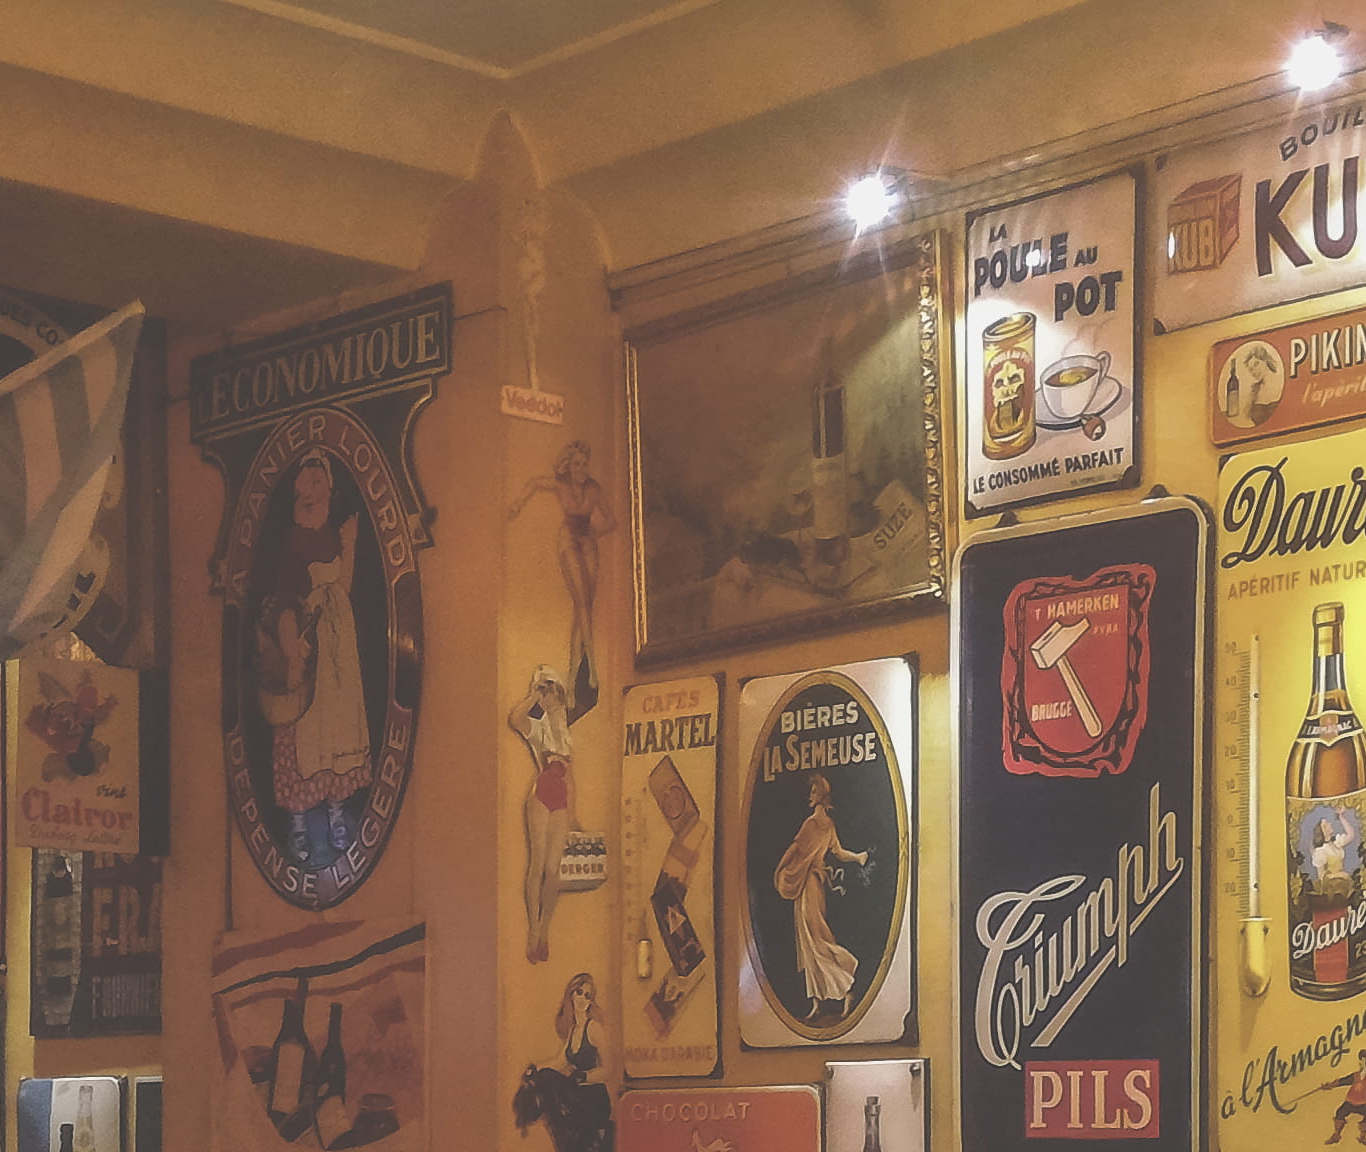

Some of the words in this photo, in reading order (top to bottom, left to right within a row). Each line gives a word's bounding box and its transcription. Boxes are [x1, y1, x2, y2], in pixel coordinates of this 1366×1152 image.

[989, 223, 1007, 244] LA
[974, 232, 1069, 297] POULE
[1074, 246, 1099, 268] AU
[1054, 270, 1124, 322] POT
[337, 423, 406, 567] LOURD
[973, 476, 985, 494] LE
[988, 456, 1061, 492] CONSOMMÉ
[1064, 447, 1125, 474] PARFAIT
[872, 501, 915, 552] SUZE
[1047, 593, 1121, 619] HAMERKEN
[1228, 570, 1300, 602] APÉRITIF
[624, 713, 716, 756] MARTEL
[780, 700, 860, 734] BIÈRES
[763, 745, 782, 783] LA
[785, 731, 878, 771] SEMEUSE
[974, 782, 1184, 1071] Triumph
[629, 1100, 753, 1122] CHOCOLAT
[1029, 1069, 1153, 1130] PILS
